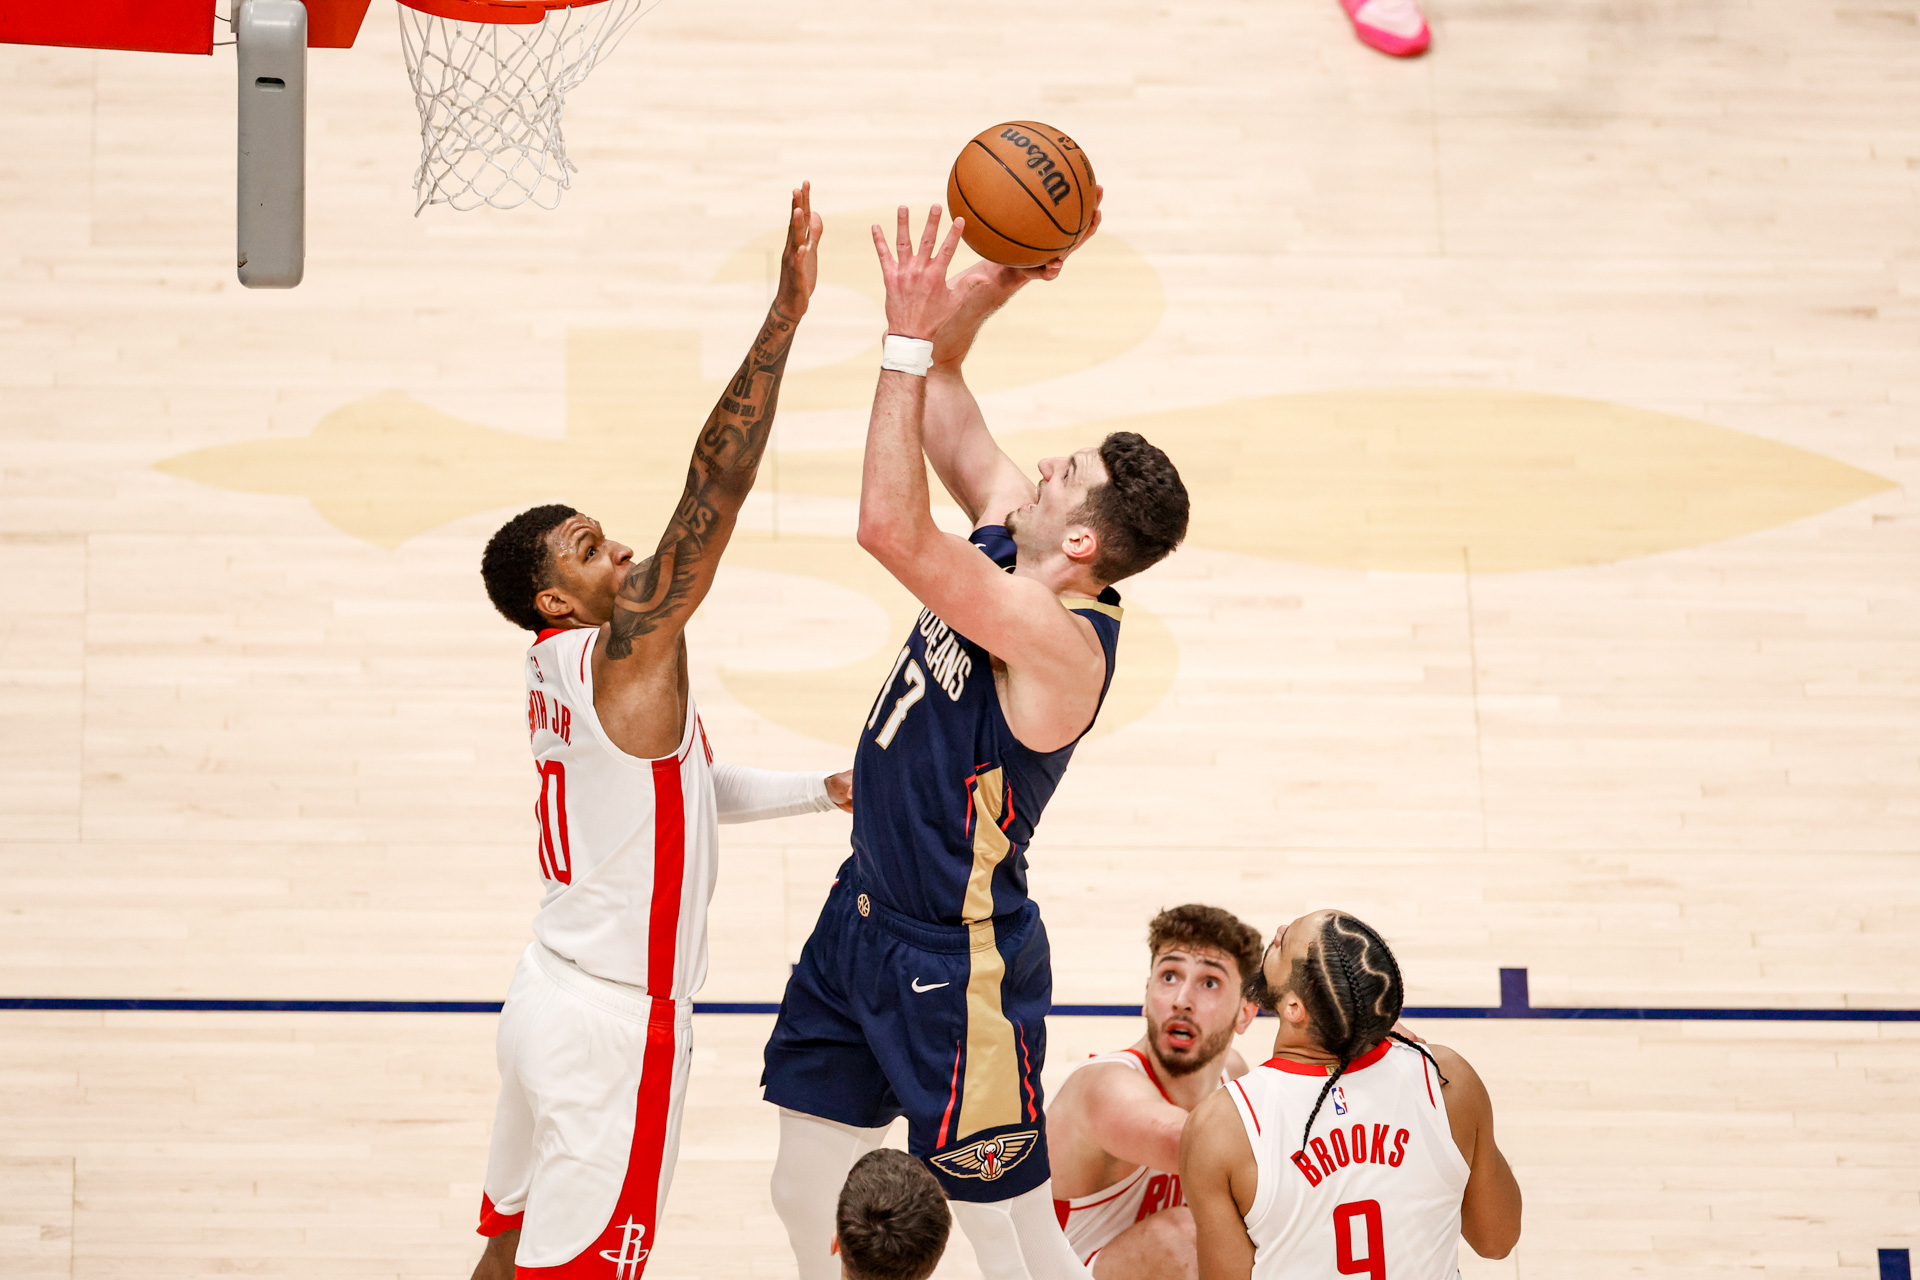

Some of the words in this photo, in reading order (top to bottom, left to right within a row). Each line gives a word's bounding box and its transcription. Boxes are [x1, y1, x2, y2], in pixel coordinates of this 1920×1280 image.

[1000, 128, 1071, 207] Wilson
[552, 697, 572, 747] JR.
[867, 645, 926, 750] 17
[1290, 1123, 1410, 1188] BROOKS
[1333, 1199, 1386, 1280] 9
